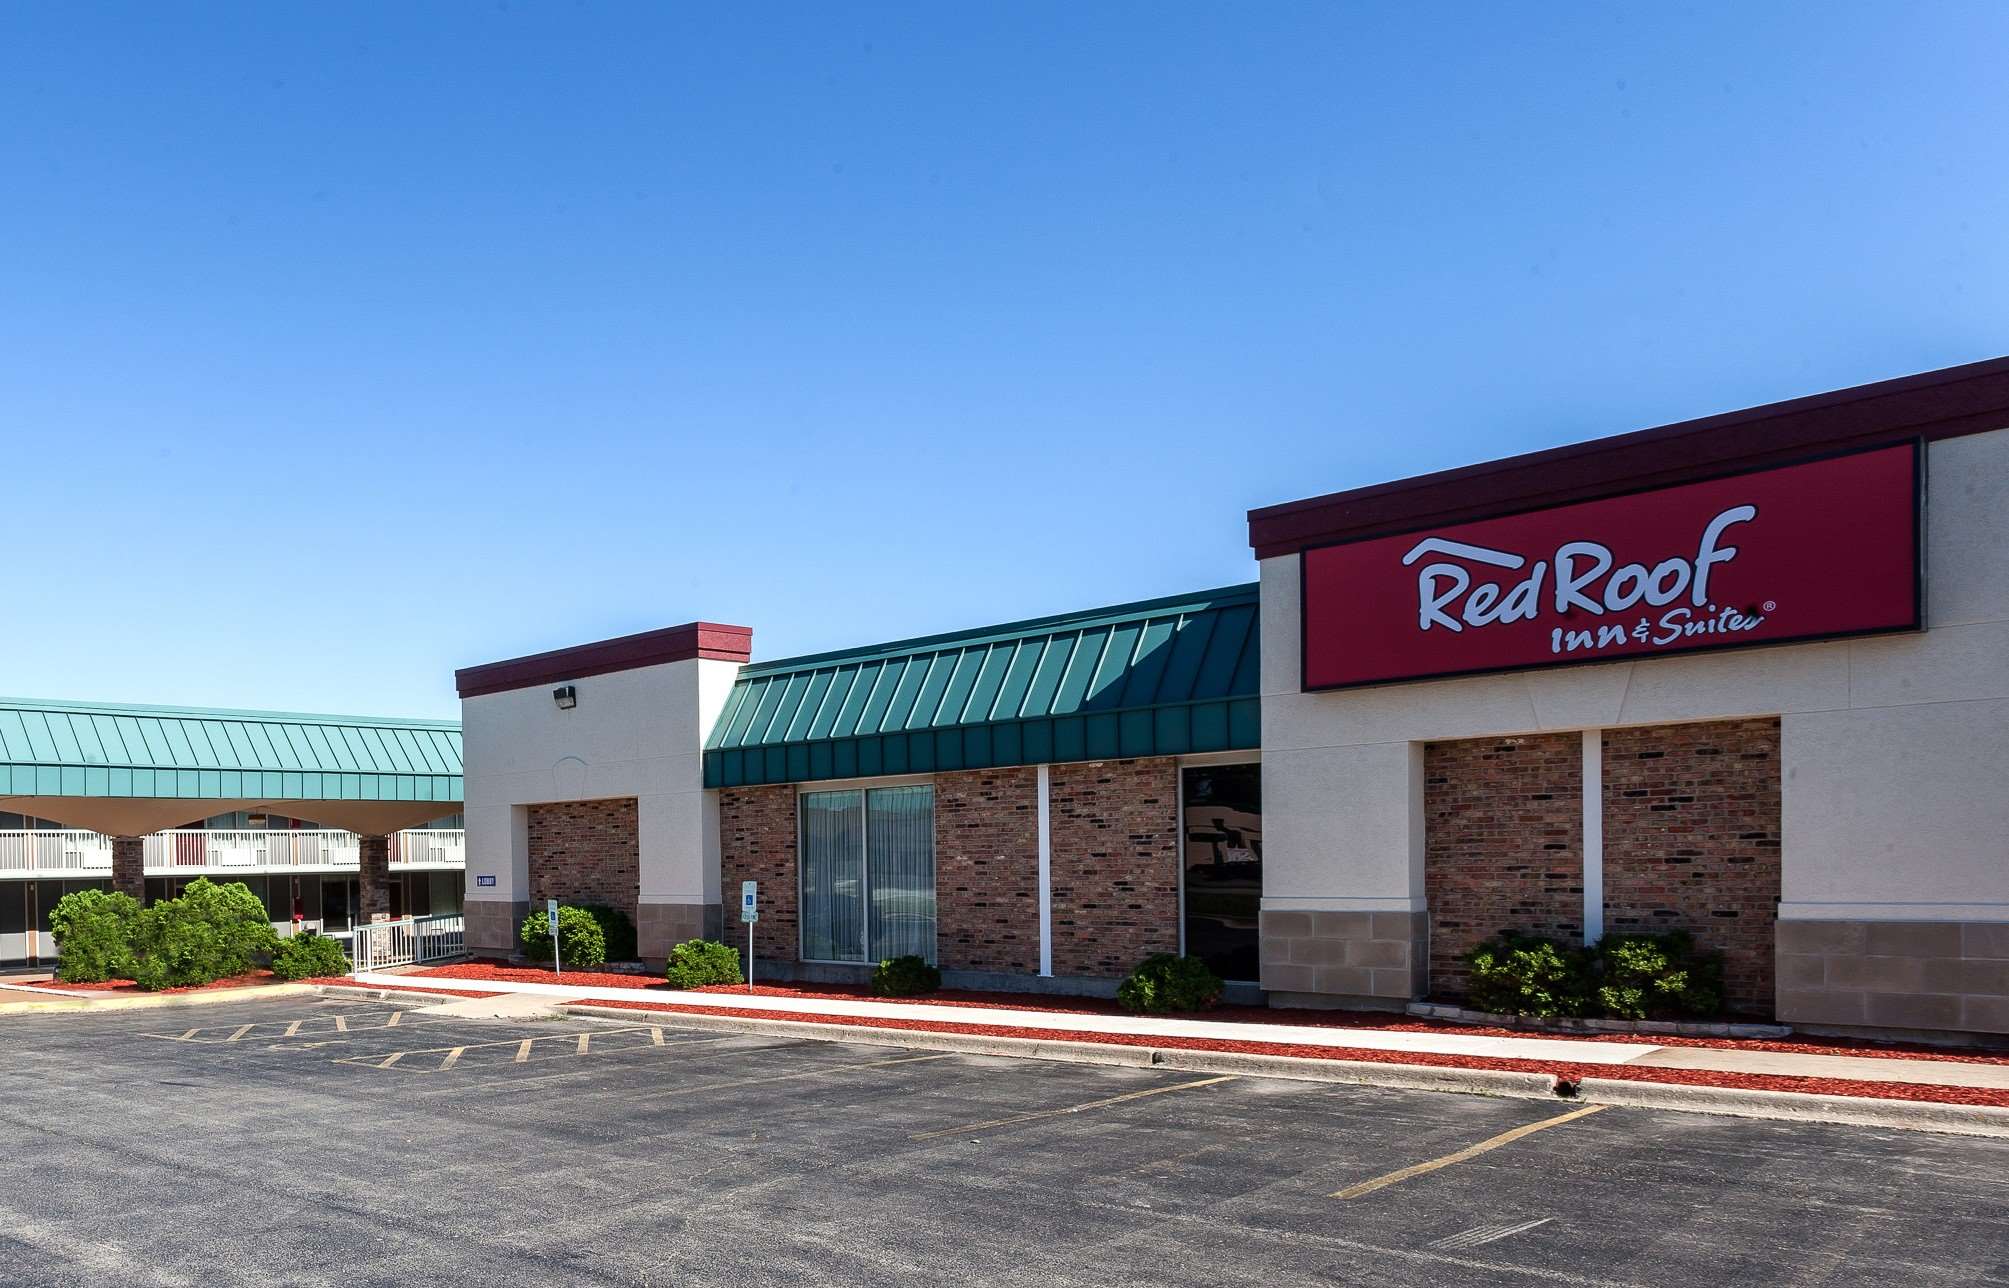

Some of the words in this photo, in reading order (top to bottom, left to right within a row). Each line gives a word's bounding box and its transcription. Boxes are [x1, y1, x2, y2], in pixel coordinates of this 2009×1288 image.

[1418, 561, 1547, 632] Red
[1554, 505, 1758, 615] Roof
[1551, 624, 1627, 653] Inn
